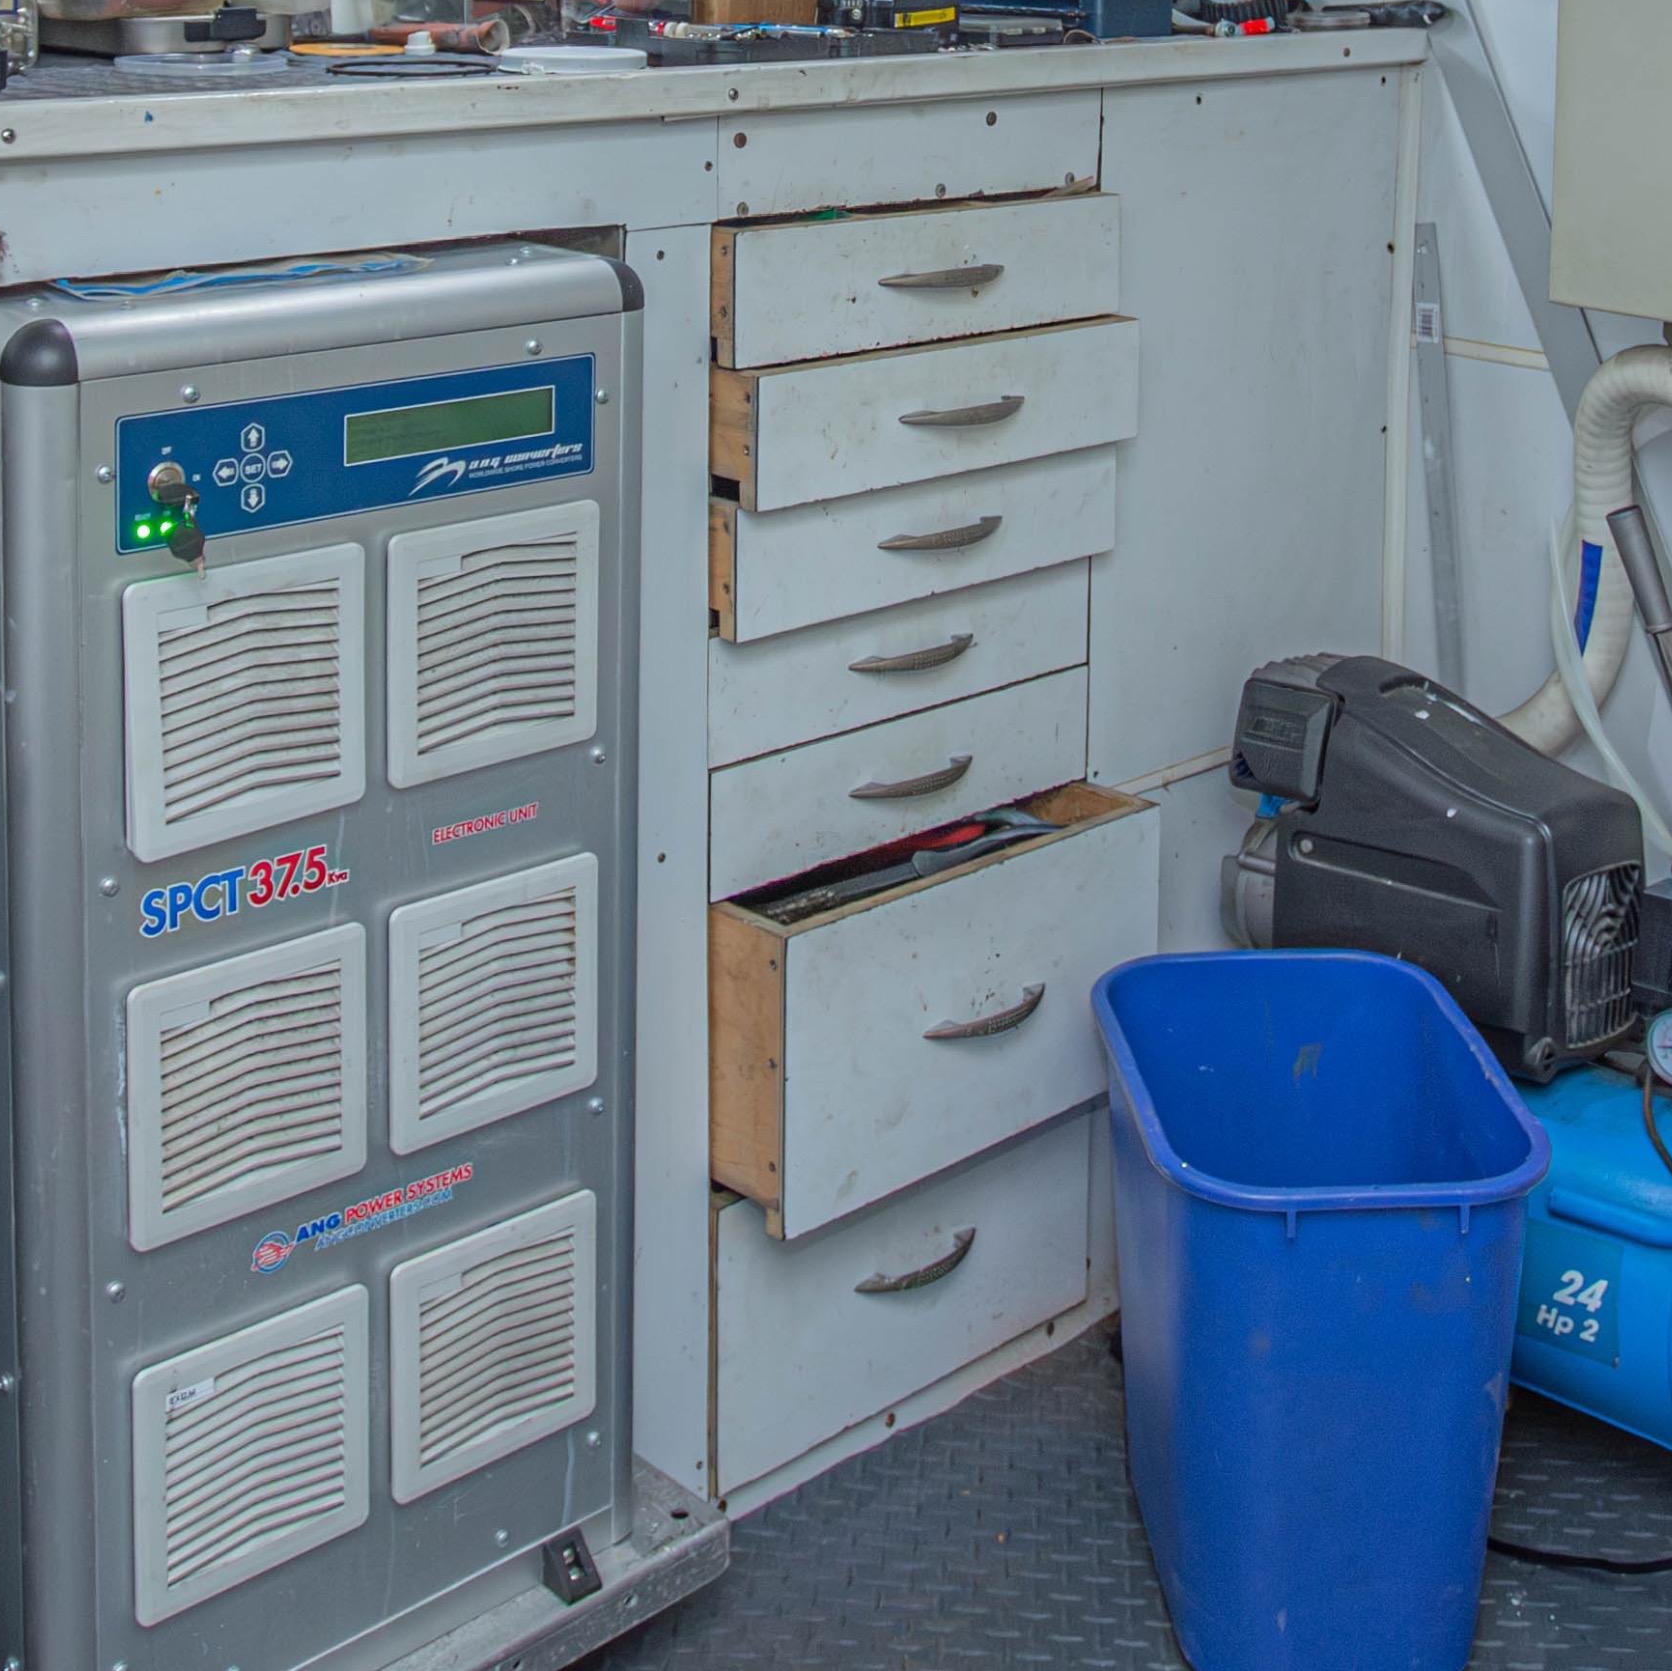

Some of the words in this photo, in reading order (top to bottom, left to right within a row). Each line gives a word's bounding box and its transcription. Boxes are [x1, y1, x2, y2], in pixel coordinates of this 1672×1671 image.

[245, 463, 263, 476] SET
[432, 813, 506, 845] ELECTRONIC
[508, 802, 539, 825] UNIT
[140, 866, 245, 937] SPCT
[246, 844, 327, 908] 37.5
[296, 1211, 342, 1245] ANG
[344, 1188, 403, 1225] POWER
[406, 1162, 473, 1201] SYSTEMS
[1553, 1269, 1609, 1313] 24
[1536, 1304, 1574, 1336] Hp
[1579, 1318, 1600, 1343] 2
